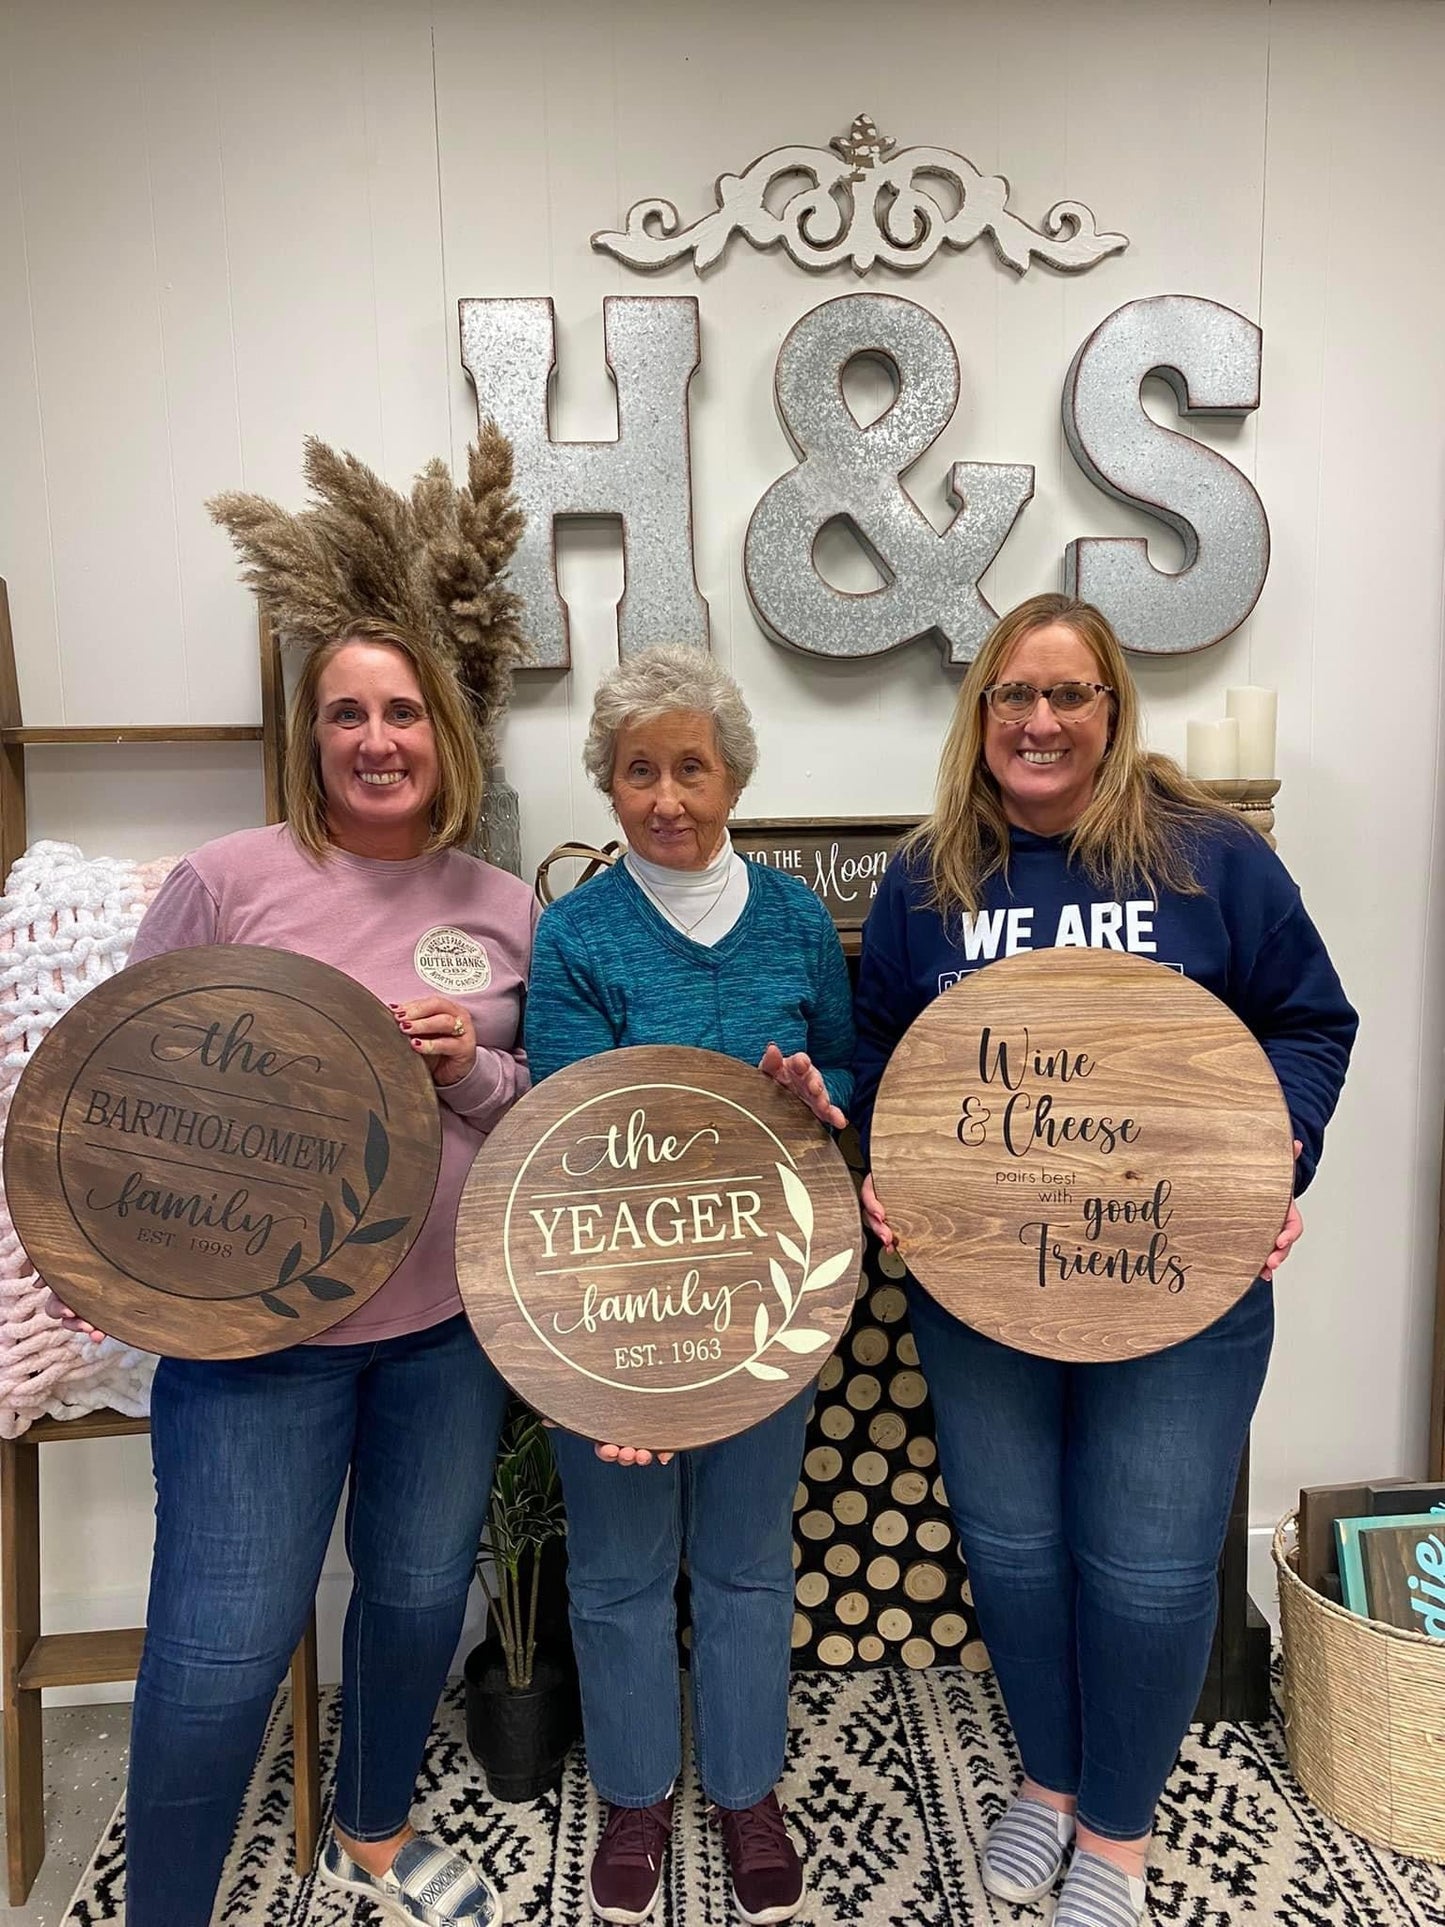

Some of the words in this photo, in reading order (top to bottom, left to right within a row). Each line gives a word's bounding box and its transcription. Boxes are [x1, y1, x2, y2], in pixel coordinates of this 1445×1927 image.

[747, 851, 767, 865] TO
[773, 850, 802, 868] THE
[813, 843, 888, 901] Moon
[420, 956, 454, 967] OUTER
[456, 957, 486, 968] BANKS
[962, 907, 1034, 960] WE
[1055, 900, 1157, 952] ARE
[430, 971, 453, 985] NORTH
[150, 1013, 321, 1077] the
[979, 1027, 1095, 1091] Wine
[82, 1089, 348, 1175] BARTHOLOMEW
[562, 1109, 719, 1176] the
[957, 1096, 991, 1147] &
[1003, 1092, 1141, 1157] Cheese
[995, 1170, 1036, 1185] pairs
[1041, 1171, 1077, 1185] best
[86, 1171, 307, 1255] family
[529, 1190, 768, 1258] YEAGER
[1038, 1188, 1073, 1204] with
[1083, 1180, 1174, 1241] good
[189, 1237, 233, 1259] 1998
[1019, 1222, 1192, 1294] Friends
[553, 1269, 762, 1334] family
[614, 1343, 663, 1370] EST.
[671, 1338, 722, 1364] 1963
